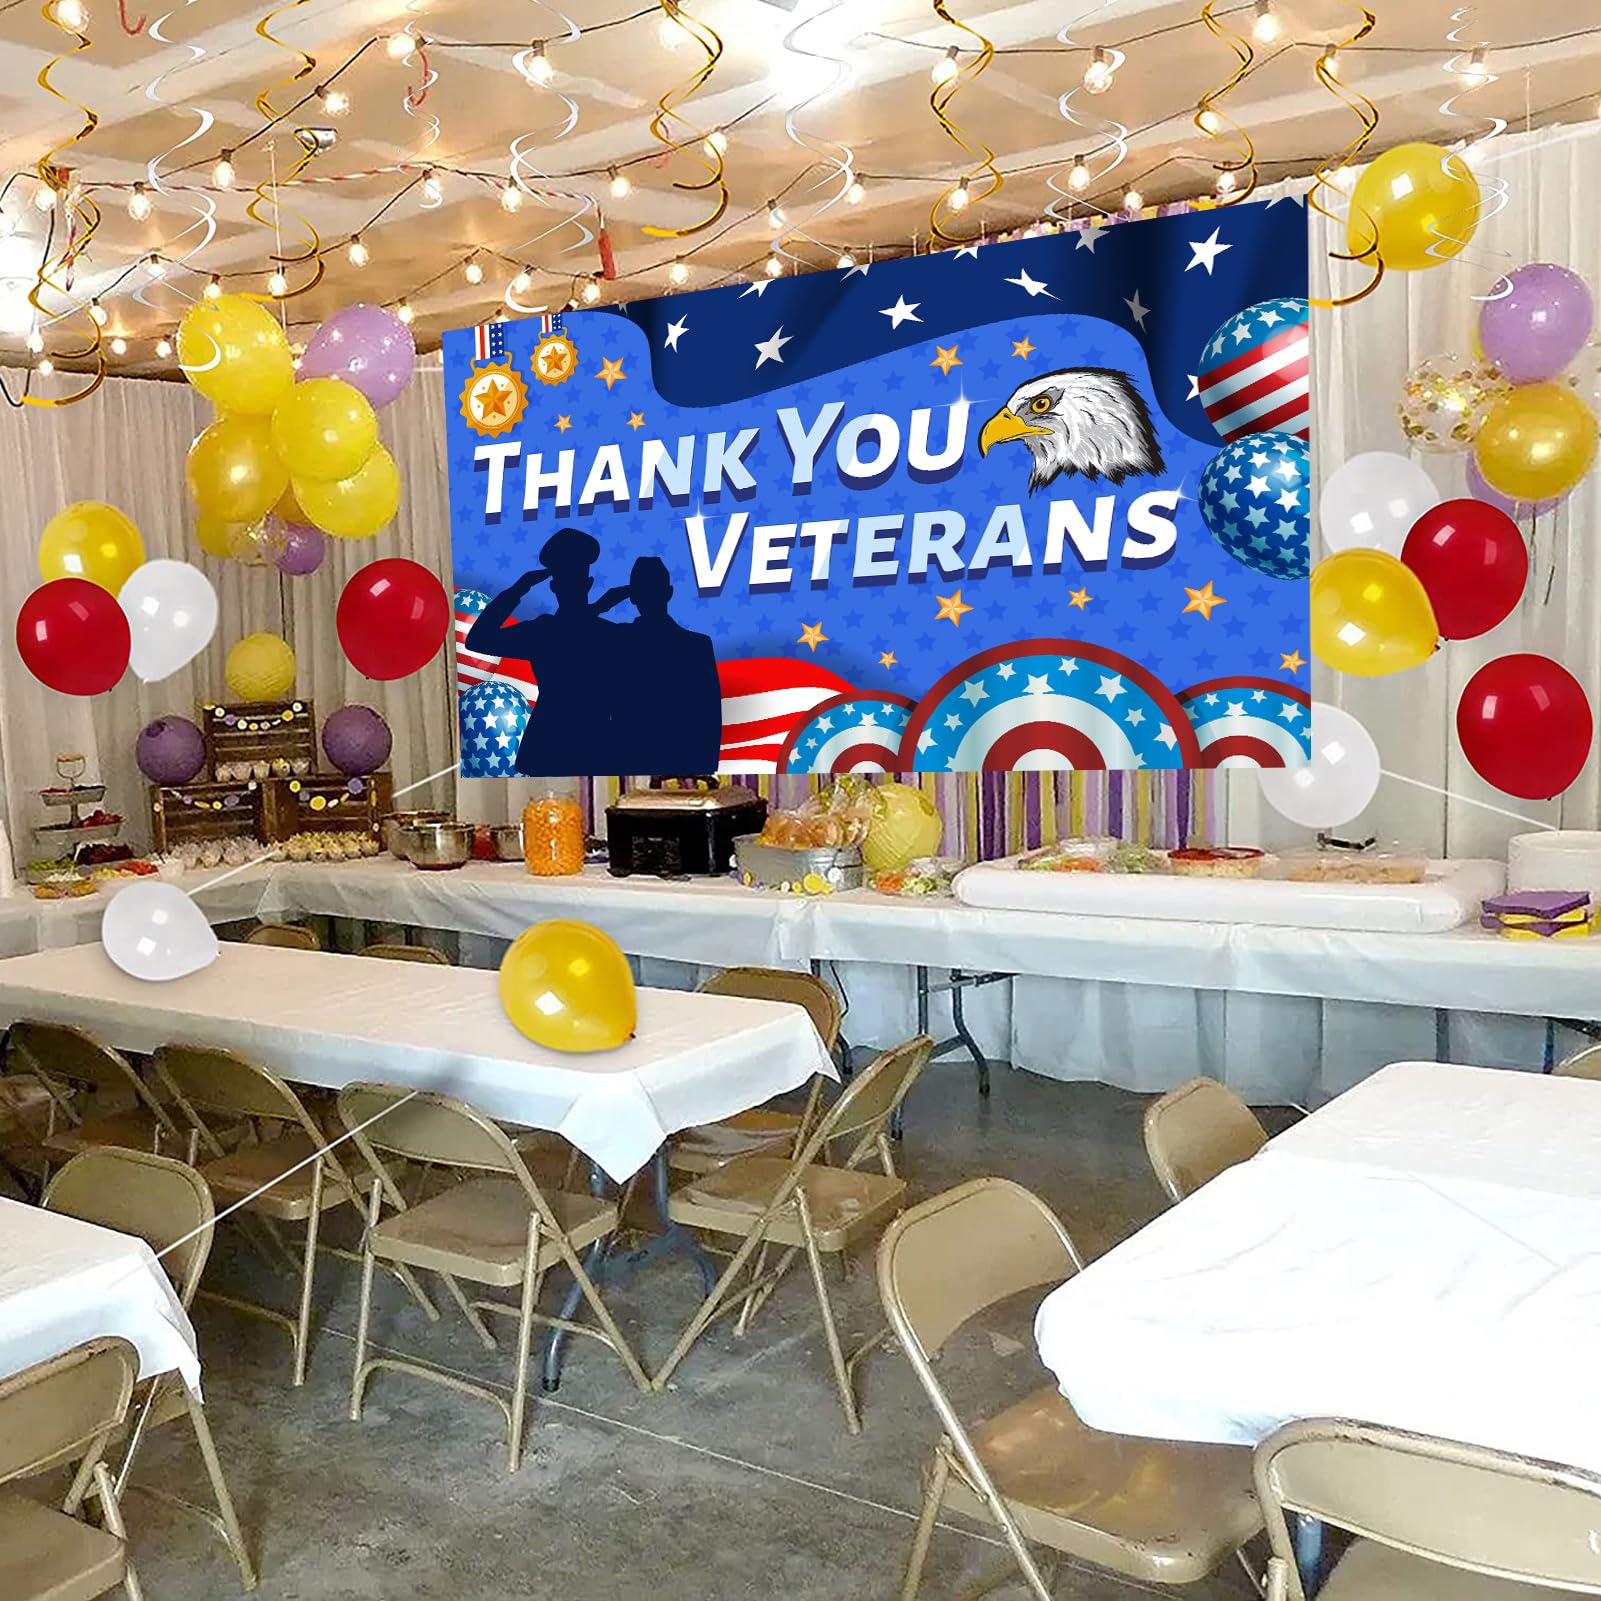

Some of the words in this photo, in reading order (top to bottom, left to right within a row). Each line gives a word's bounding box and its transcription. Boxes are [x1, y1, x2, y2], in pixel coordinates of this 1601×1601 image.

[473, 426, 760, 516] THANK
[775, 399, 971, 486] YOU
[682, 488, 1181, 590] VETERANS
